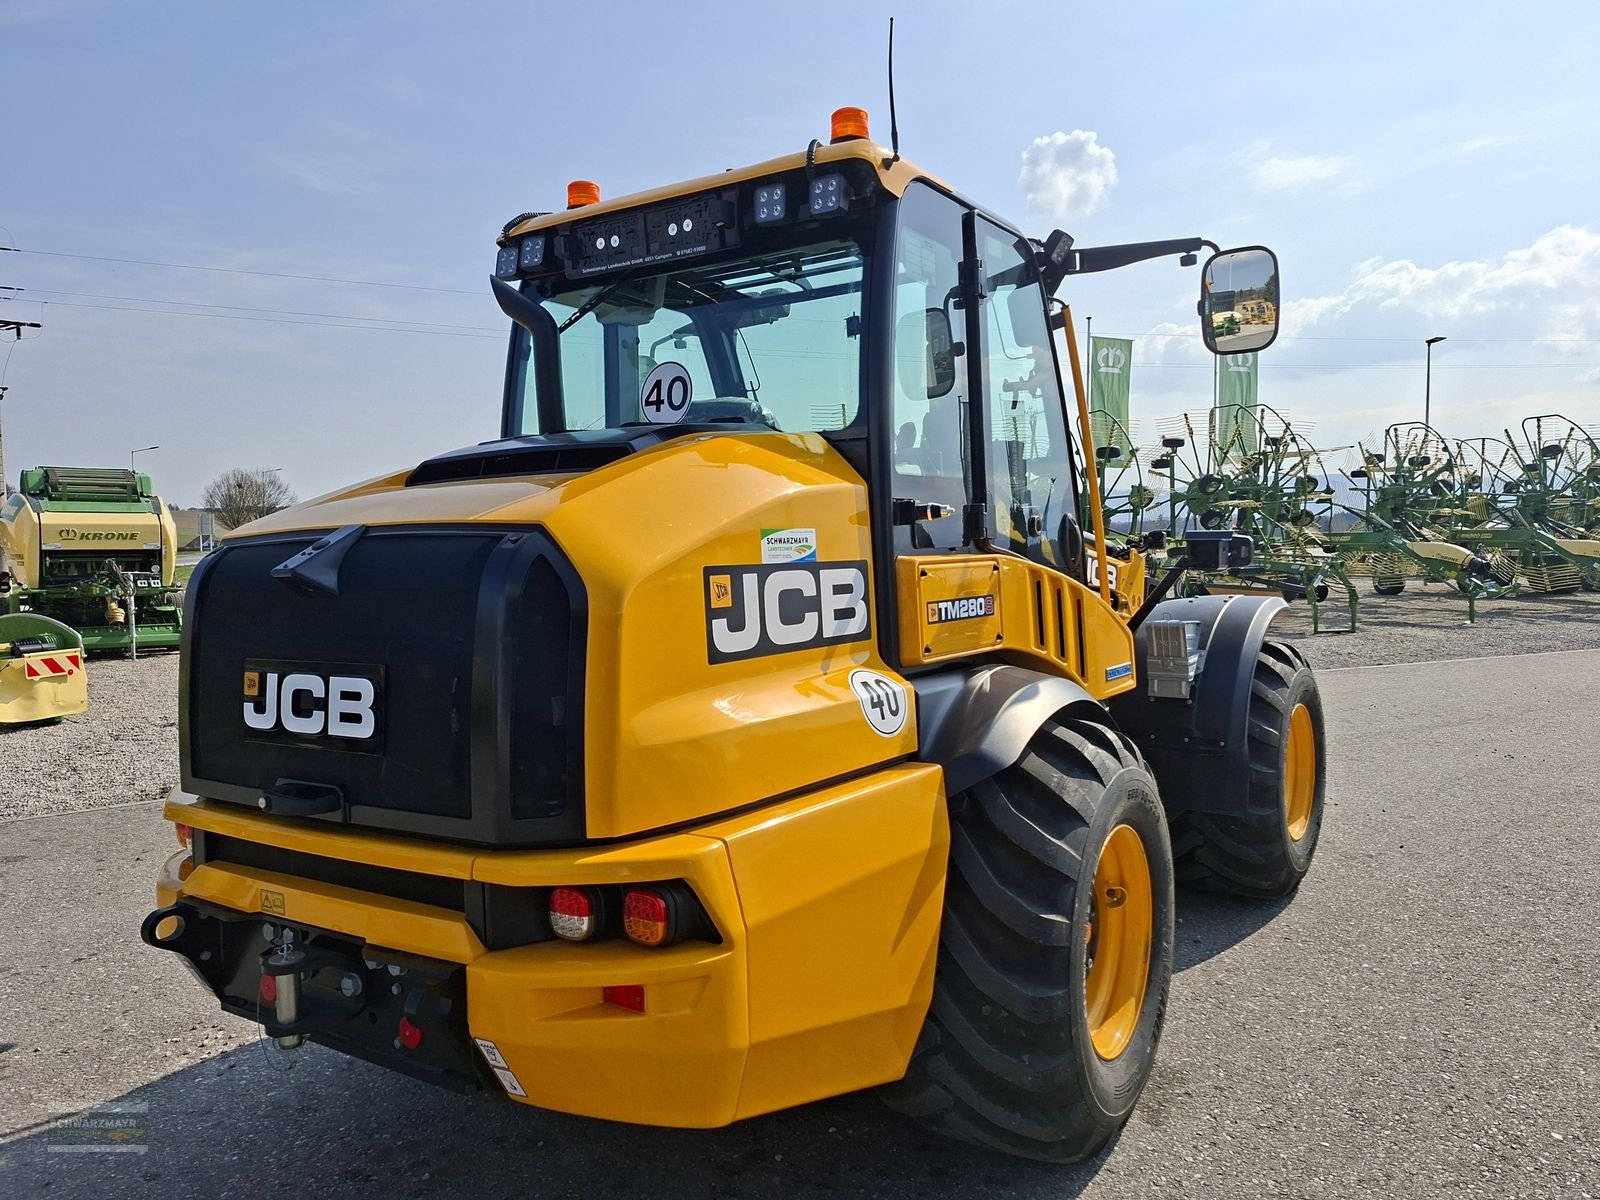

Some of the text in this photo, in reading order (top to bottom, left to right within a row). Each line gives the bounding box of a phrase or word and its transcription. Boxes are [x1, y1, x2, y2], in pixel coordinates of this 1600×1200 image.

[644, 376, 688, 413] 40
[79, 532, 140, 541] KRONE
[766, 536, 809, 545] SCHWARZMAYR
[711, 568, 868, 653] JCB
[243, 672, 375, 739] JCB
[860, 679, 900, 720] 40
